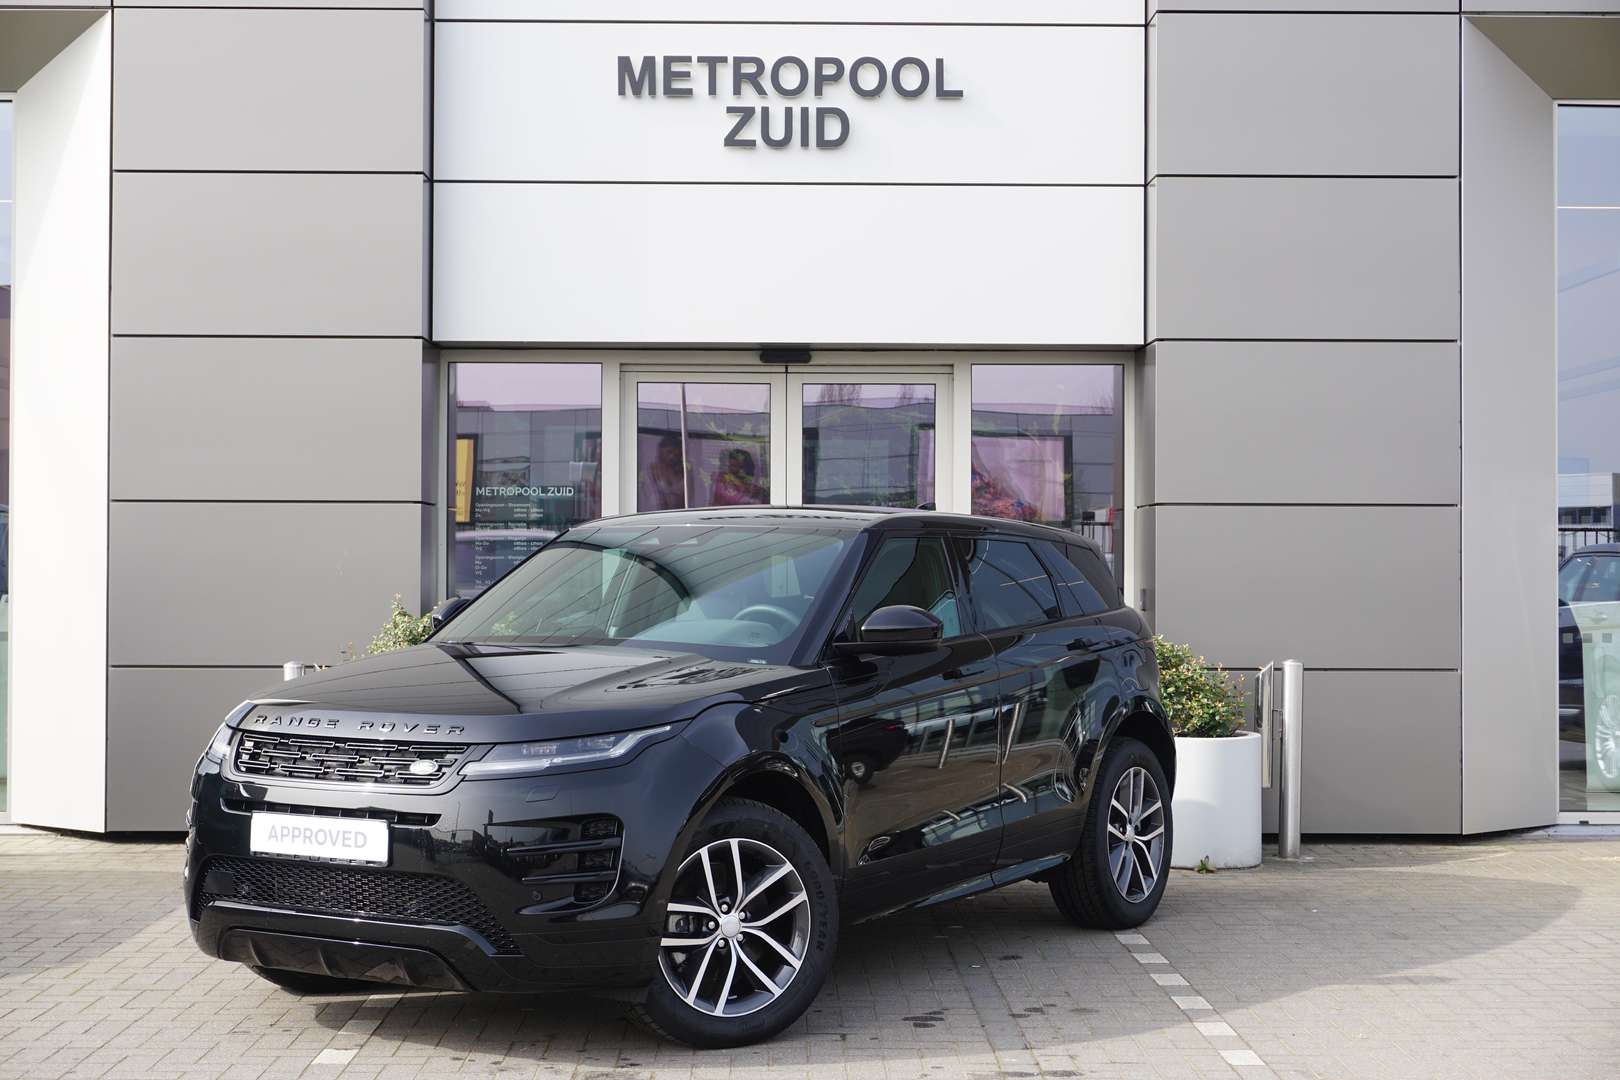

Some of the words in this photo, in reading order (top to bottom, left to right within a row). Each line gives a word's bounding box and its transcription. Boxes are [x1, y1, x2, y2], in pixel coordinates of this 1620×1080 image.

[617, 55, 964, 98] METROPOOL
[723, 106, 850, 149] ZUID
[475, 486, 545, 496] METROPOOL
[547, 486, 574, 496] ZUID
[254, 714, 340, 729] RANGE
[357, 720, 465, 736] ROVER
[268, 824, 367, 849] APPROVED
